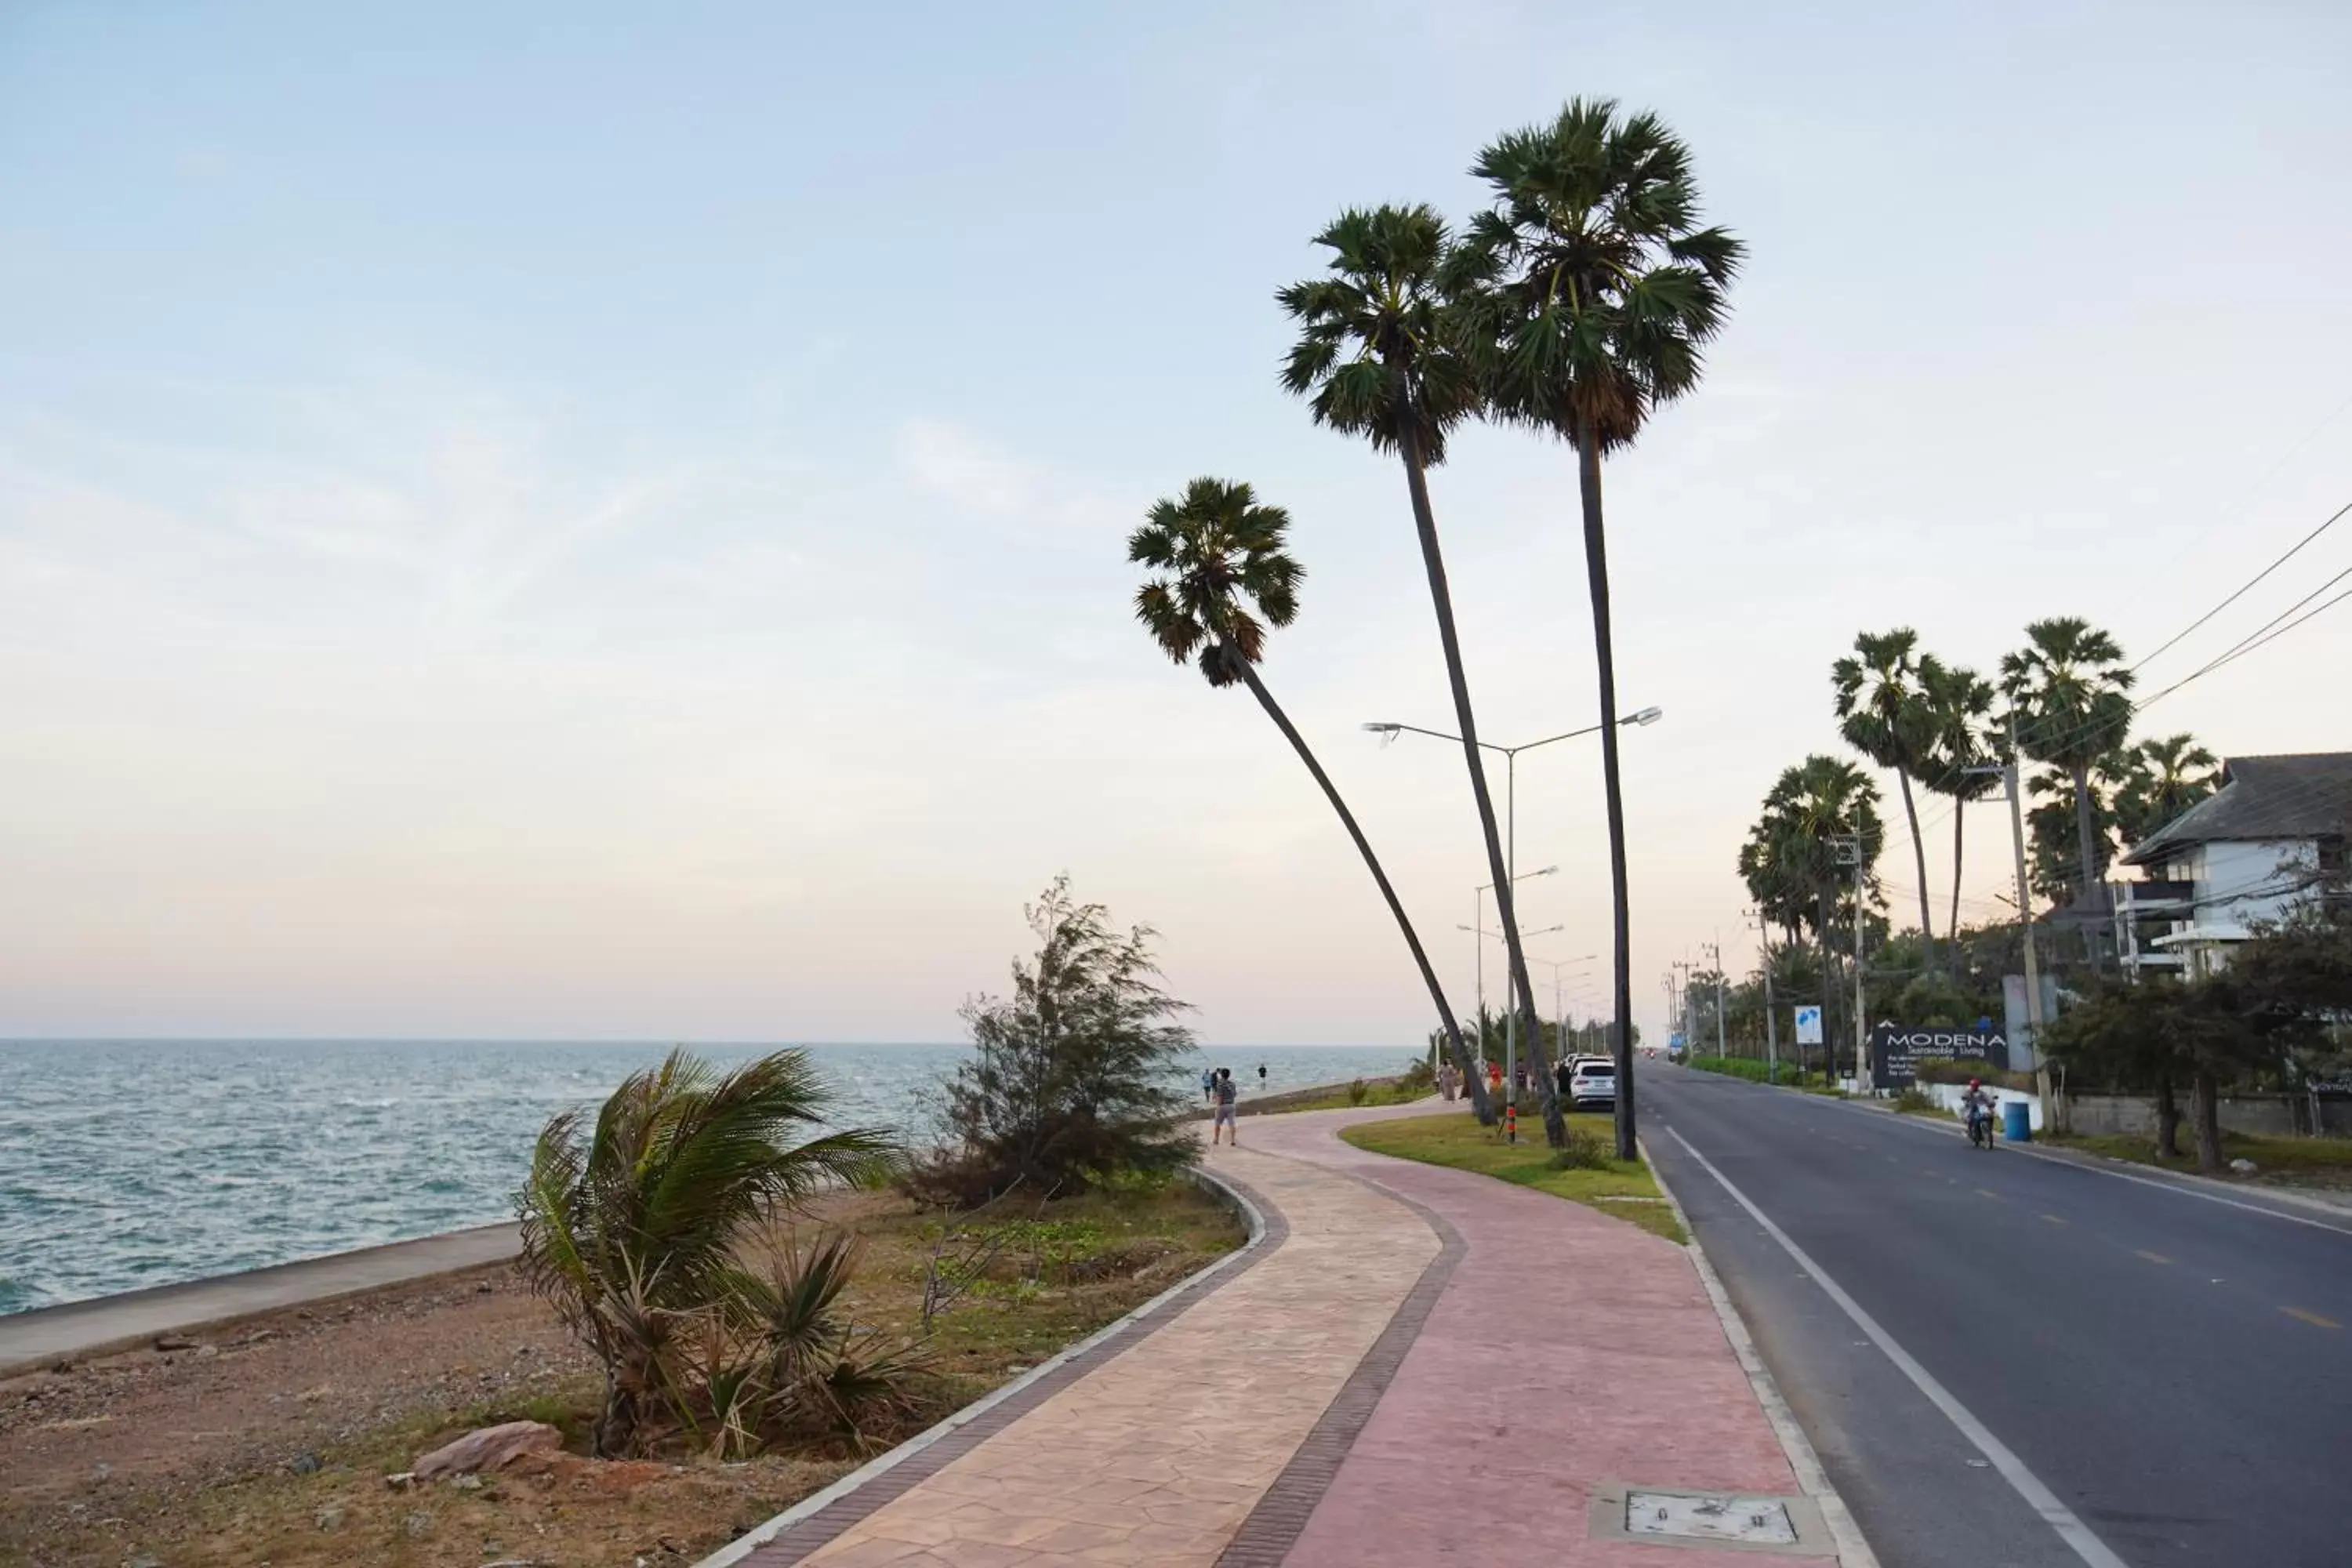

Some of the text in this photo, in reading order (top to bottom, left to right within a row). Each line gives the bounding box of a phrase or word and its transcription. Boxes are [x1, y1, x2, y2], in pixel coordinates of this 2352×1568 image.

[1887, 1033, 2006, 1047] MODENA
[1907, 1045, 1984, 1057] Sustainable Living
